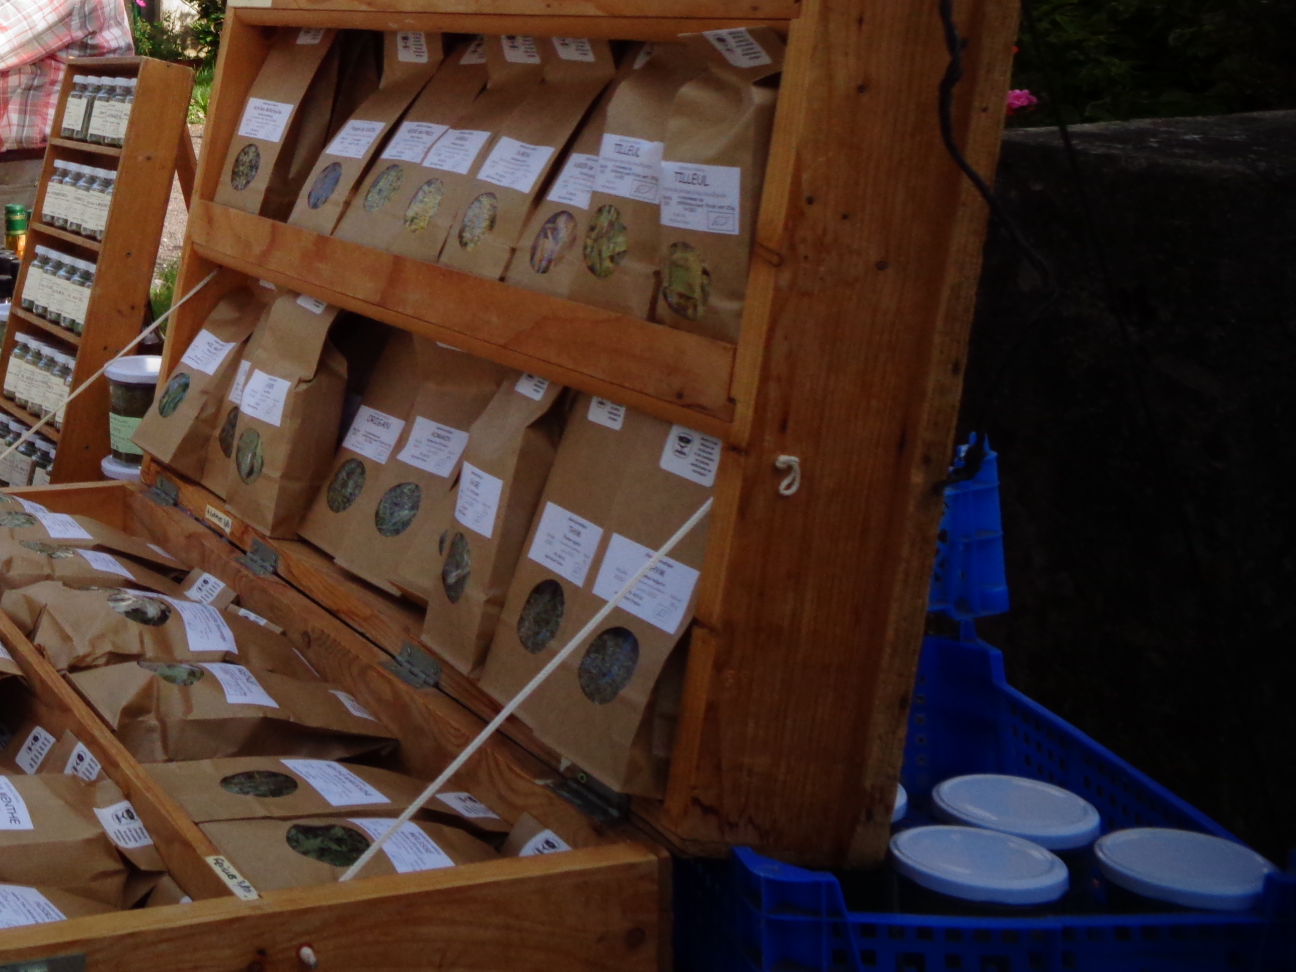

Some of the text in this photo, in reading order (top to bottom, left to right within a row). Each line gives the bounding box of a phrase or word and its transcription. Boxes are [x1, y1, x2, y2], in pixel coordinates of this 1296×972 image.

[613, 143, 641, 158] TILLEUL
[674, 171, 709, 186] TILLEUL
[366, 414, 391, 430] ORIGAN
